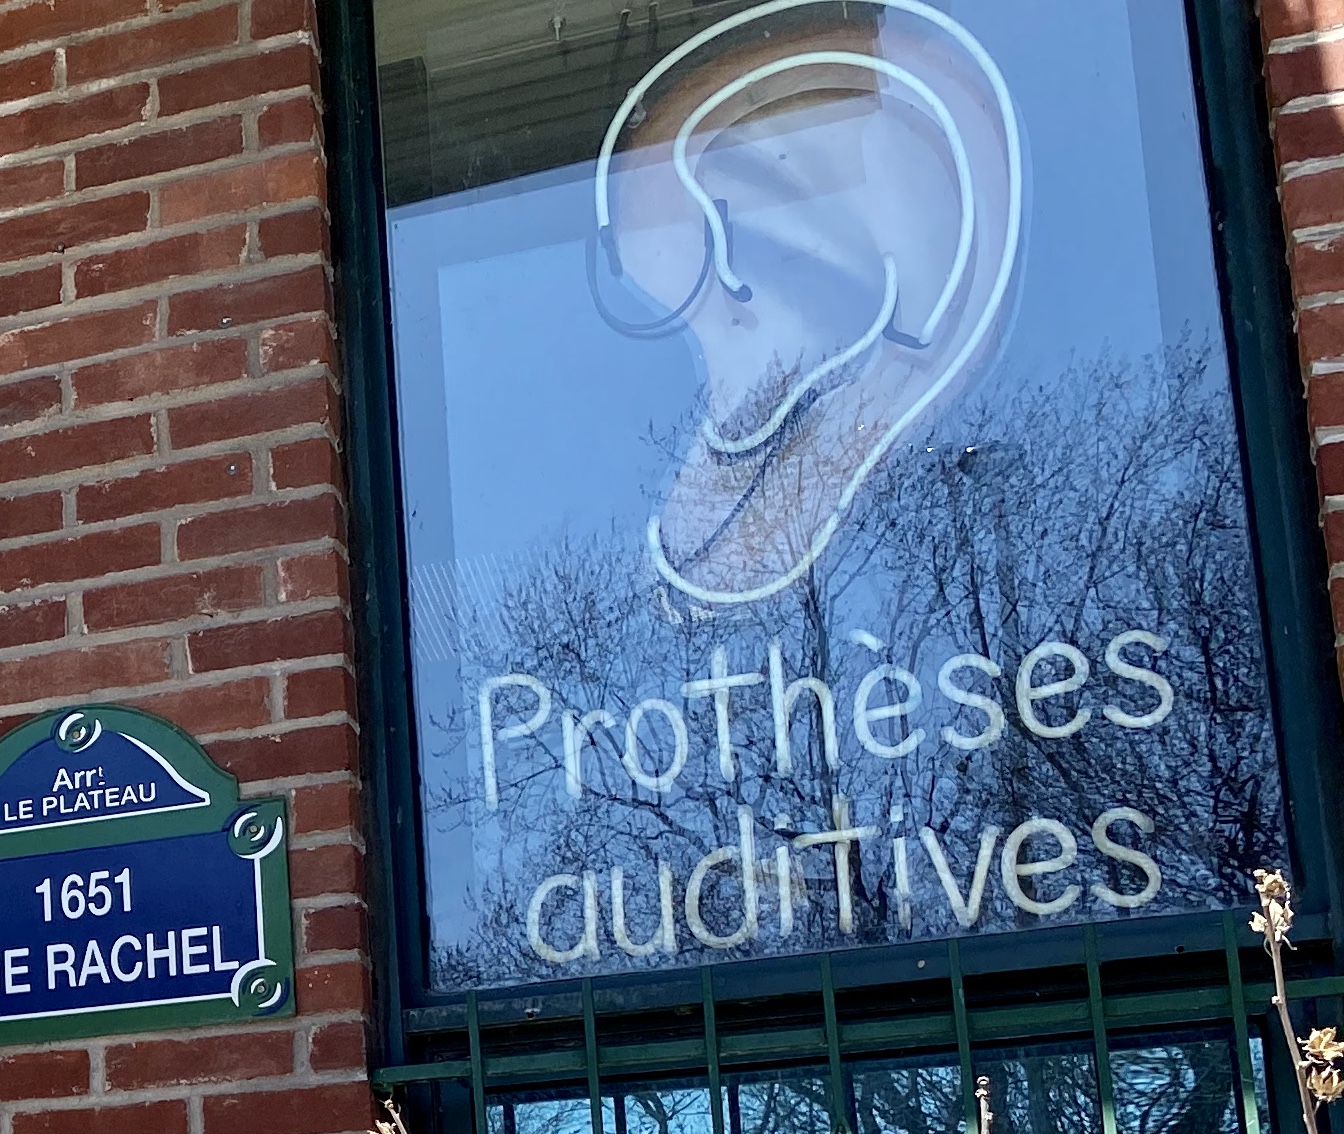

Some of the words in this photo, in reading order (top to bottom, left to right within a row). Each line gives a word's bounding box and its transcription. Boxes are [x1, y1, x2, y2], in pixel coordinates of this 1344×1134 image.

[478, 628, 1176, 812] Prothèses
[4, 799, 33, 822] LE
[42, 783, 156, 816] PLATEAU
[35, 867, 133, 922] 1651
[525, 793, 1164, 966] auditives
[47, 925, 240, 990] RACHEL
